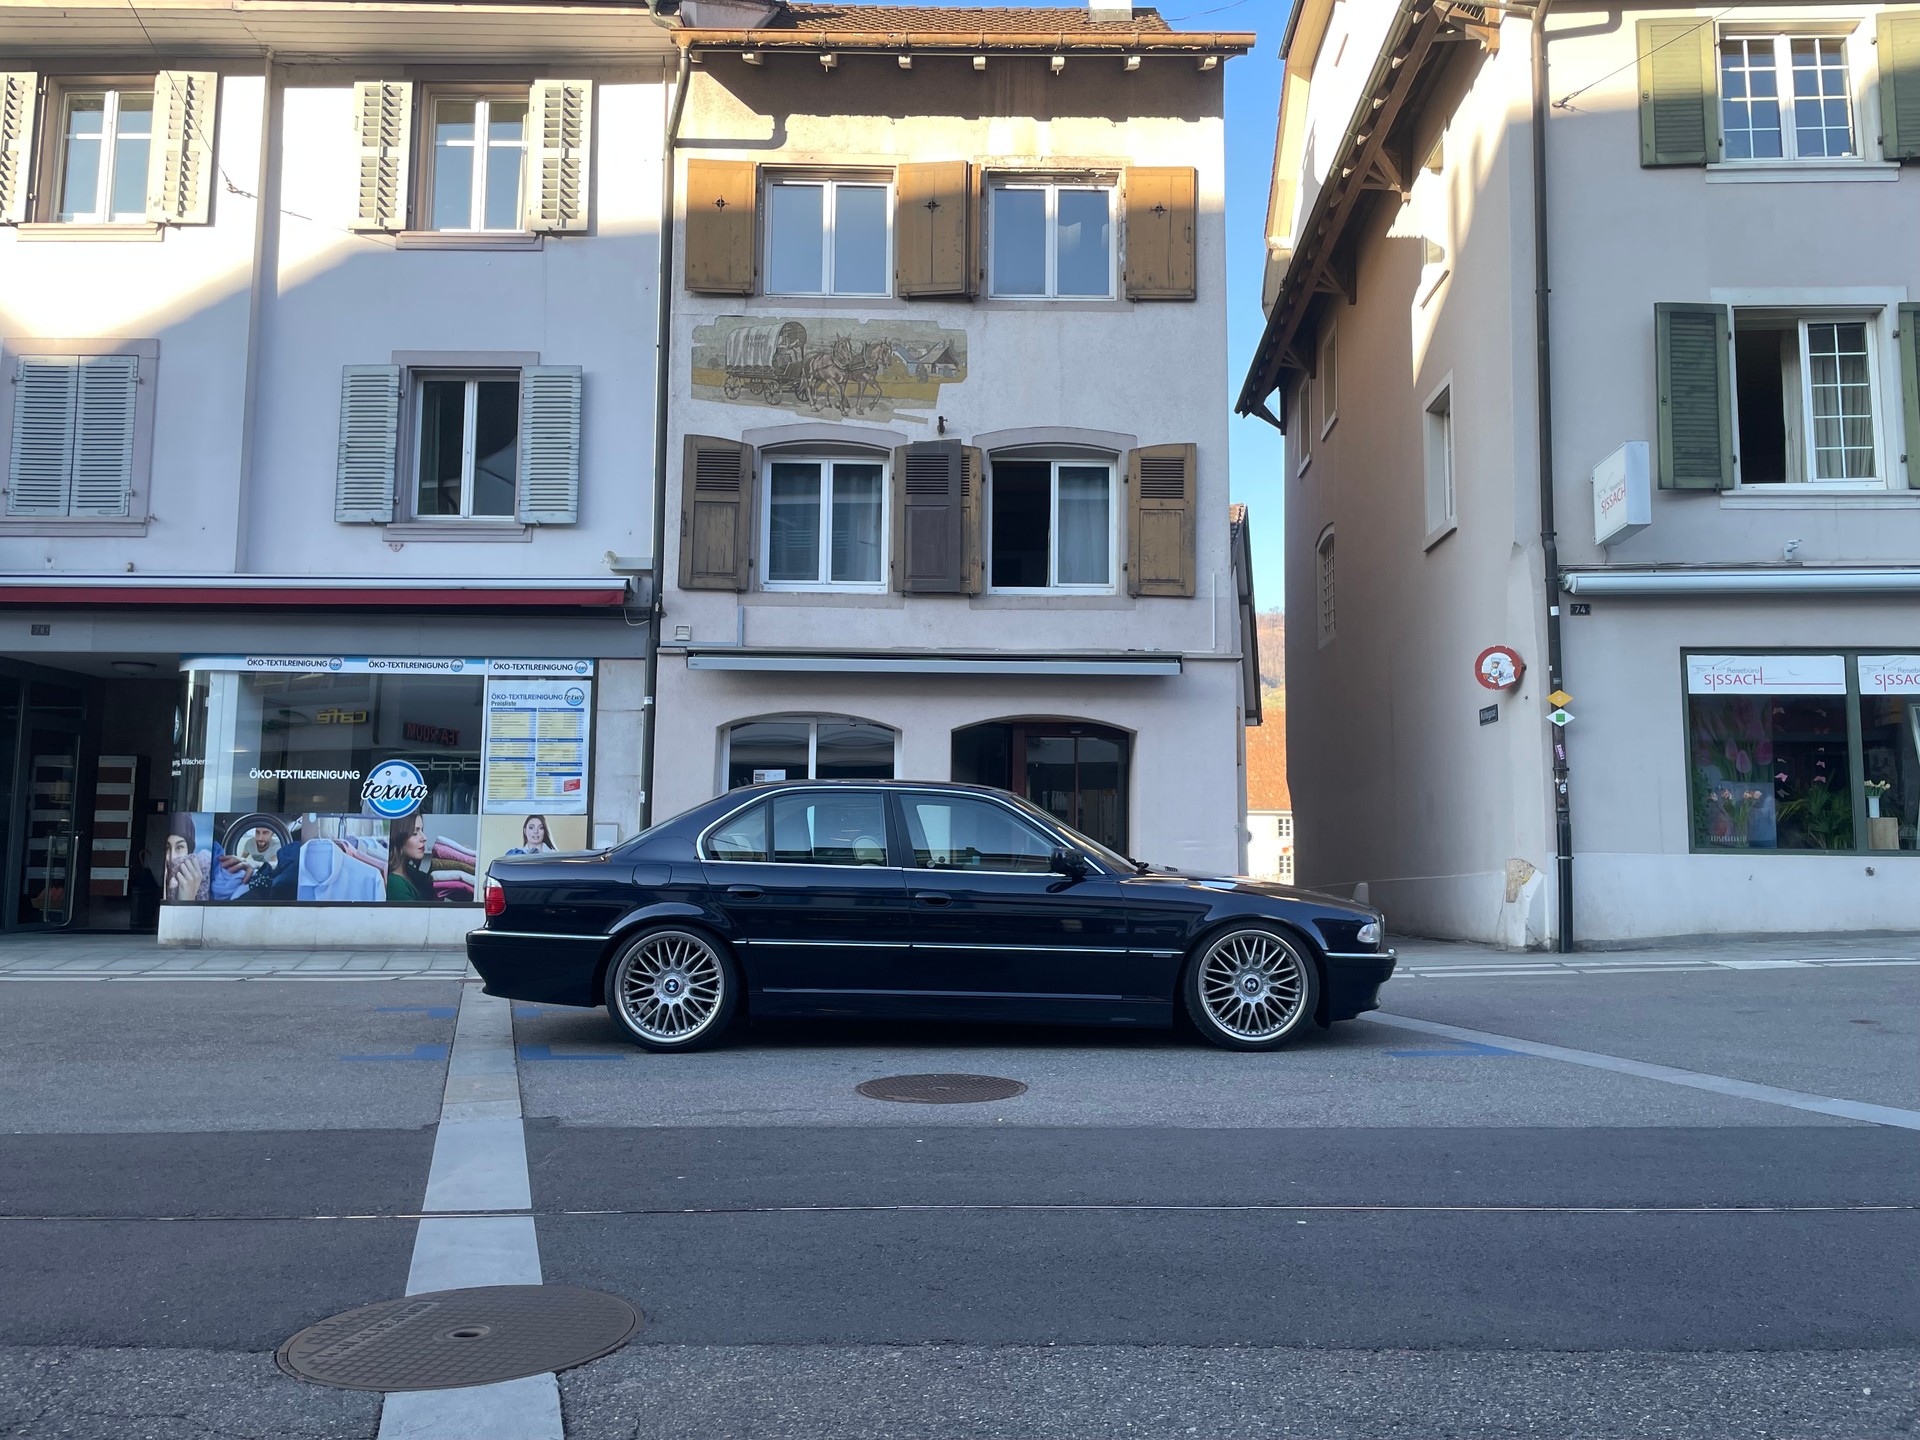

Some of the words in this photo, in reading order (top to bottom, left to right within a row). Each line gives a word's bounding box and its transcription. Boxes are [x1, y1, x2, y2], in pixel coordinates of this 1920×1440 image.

[1601, 474, 1626, 519] SISSACH
[1575, 605, 1586, 614] 74
[247, 658, 328, 668] ÖKO-TEXTILREINIGUNG
[368, 660, 449, 670] ÖKO-TEXTILREINIGUNG
[493, 662, 573, 671] ÖKO-TEXTILREINIGUNG
[1704, 666, 1763, 691] SISSACH
[249, 768, 360, 780] ÖKO-TEXTILREINIGUNG
[362, 779, 427, 800] texwa
